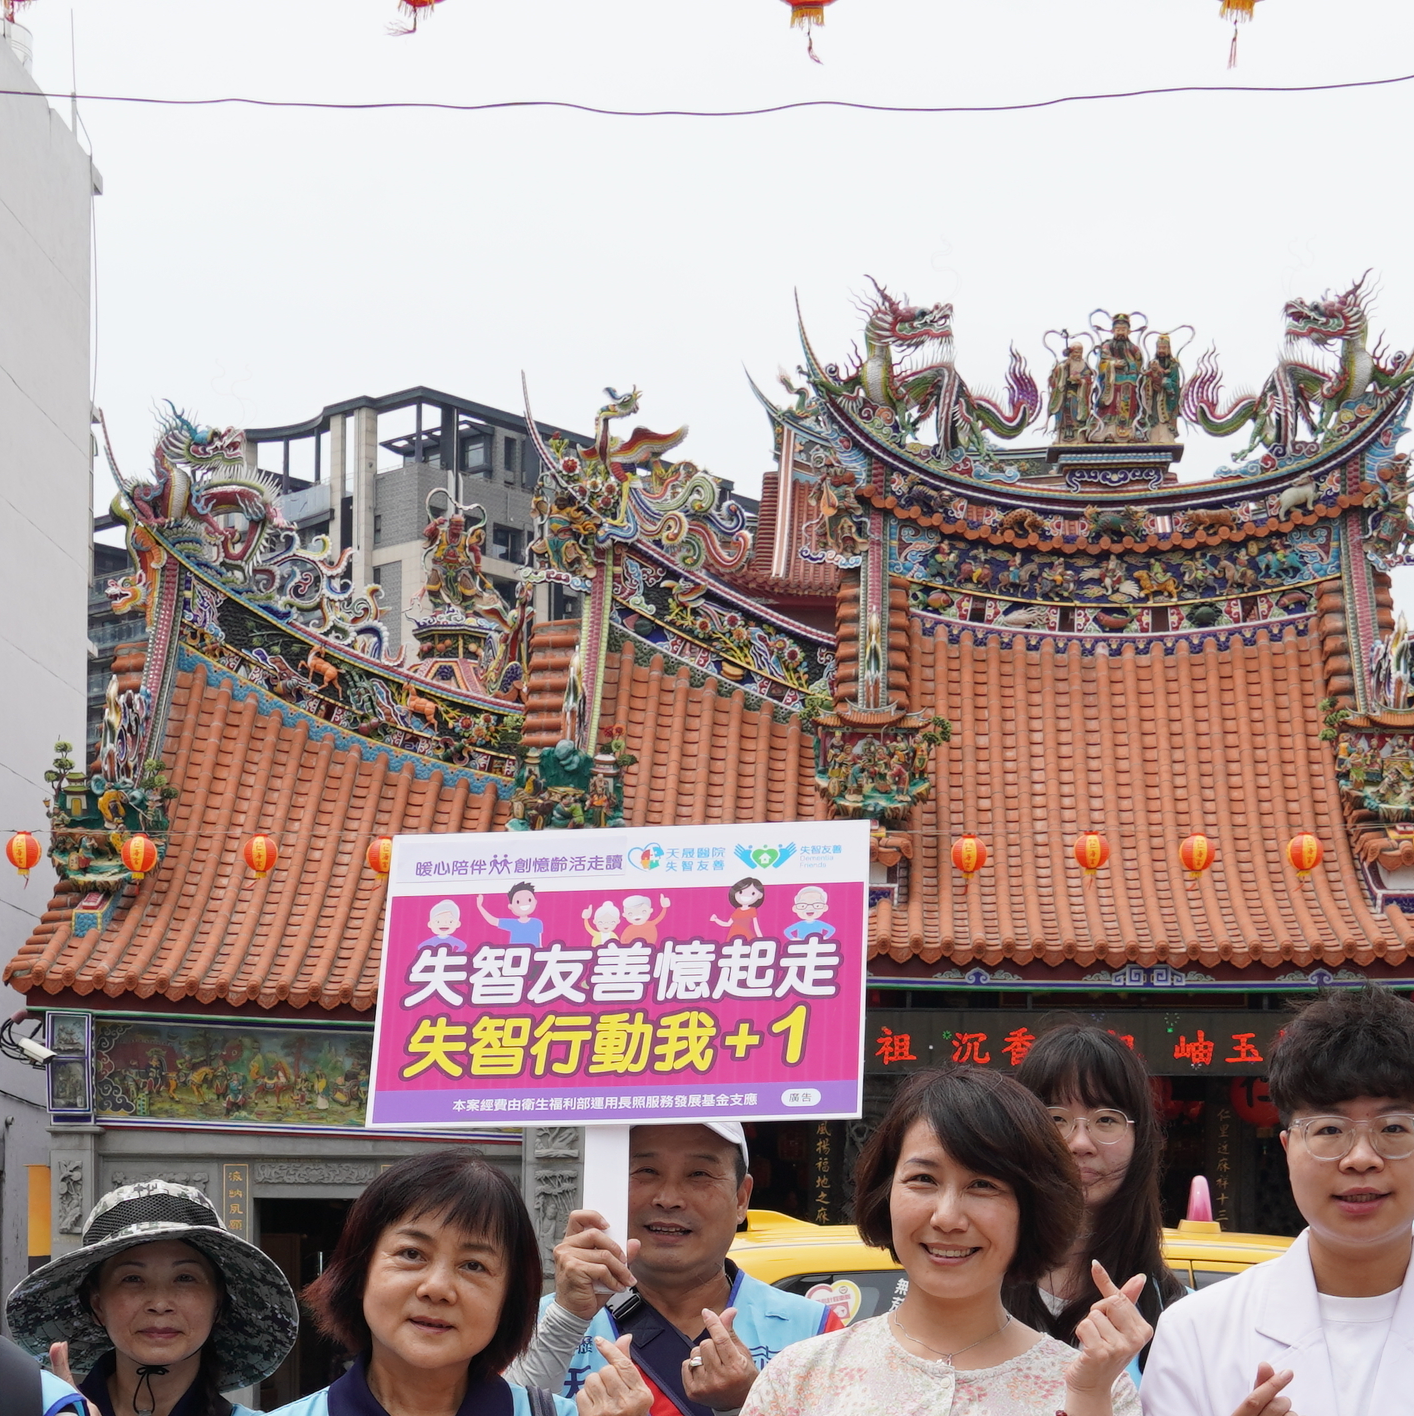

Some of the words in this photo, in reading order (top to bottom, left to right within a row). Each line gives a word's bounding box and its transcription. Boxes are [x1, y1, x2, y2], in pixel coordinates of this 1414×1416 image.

[666, 847, 726, 859] 天晟醫院
[799, 845, 843, 854] 失智友善
[514, 854, 623, 874] 創憶齡活走讀
[665, 859, 726, 872] 失智友善
[403, 938, 840, 1007] 失智友善憶起走
[402, 1005, 809, 1078] 失智行動我+1
[452, 1092, 757, 1113] 本案經費由衛生福利部運用長照服務發展基金支應
[788, 1091, 813, 1104] 廣告
